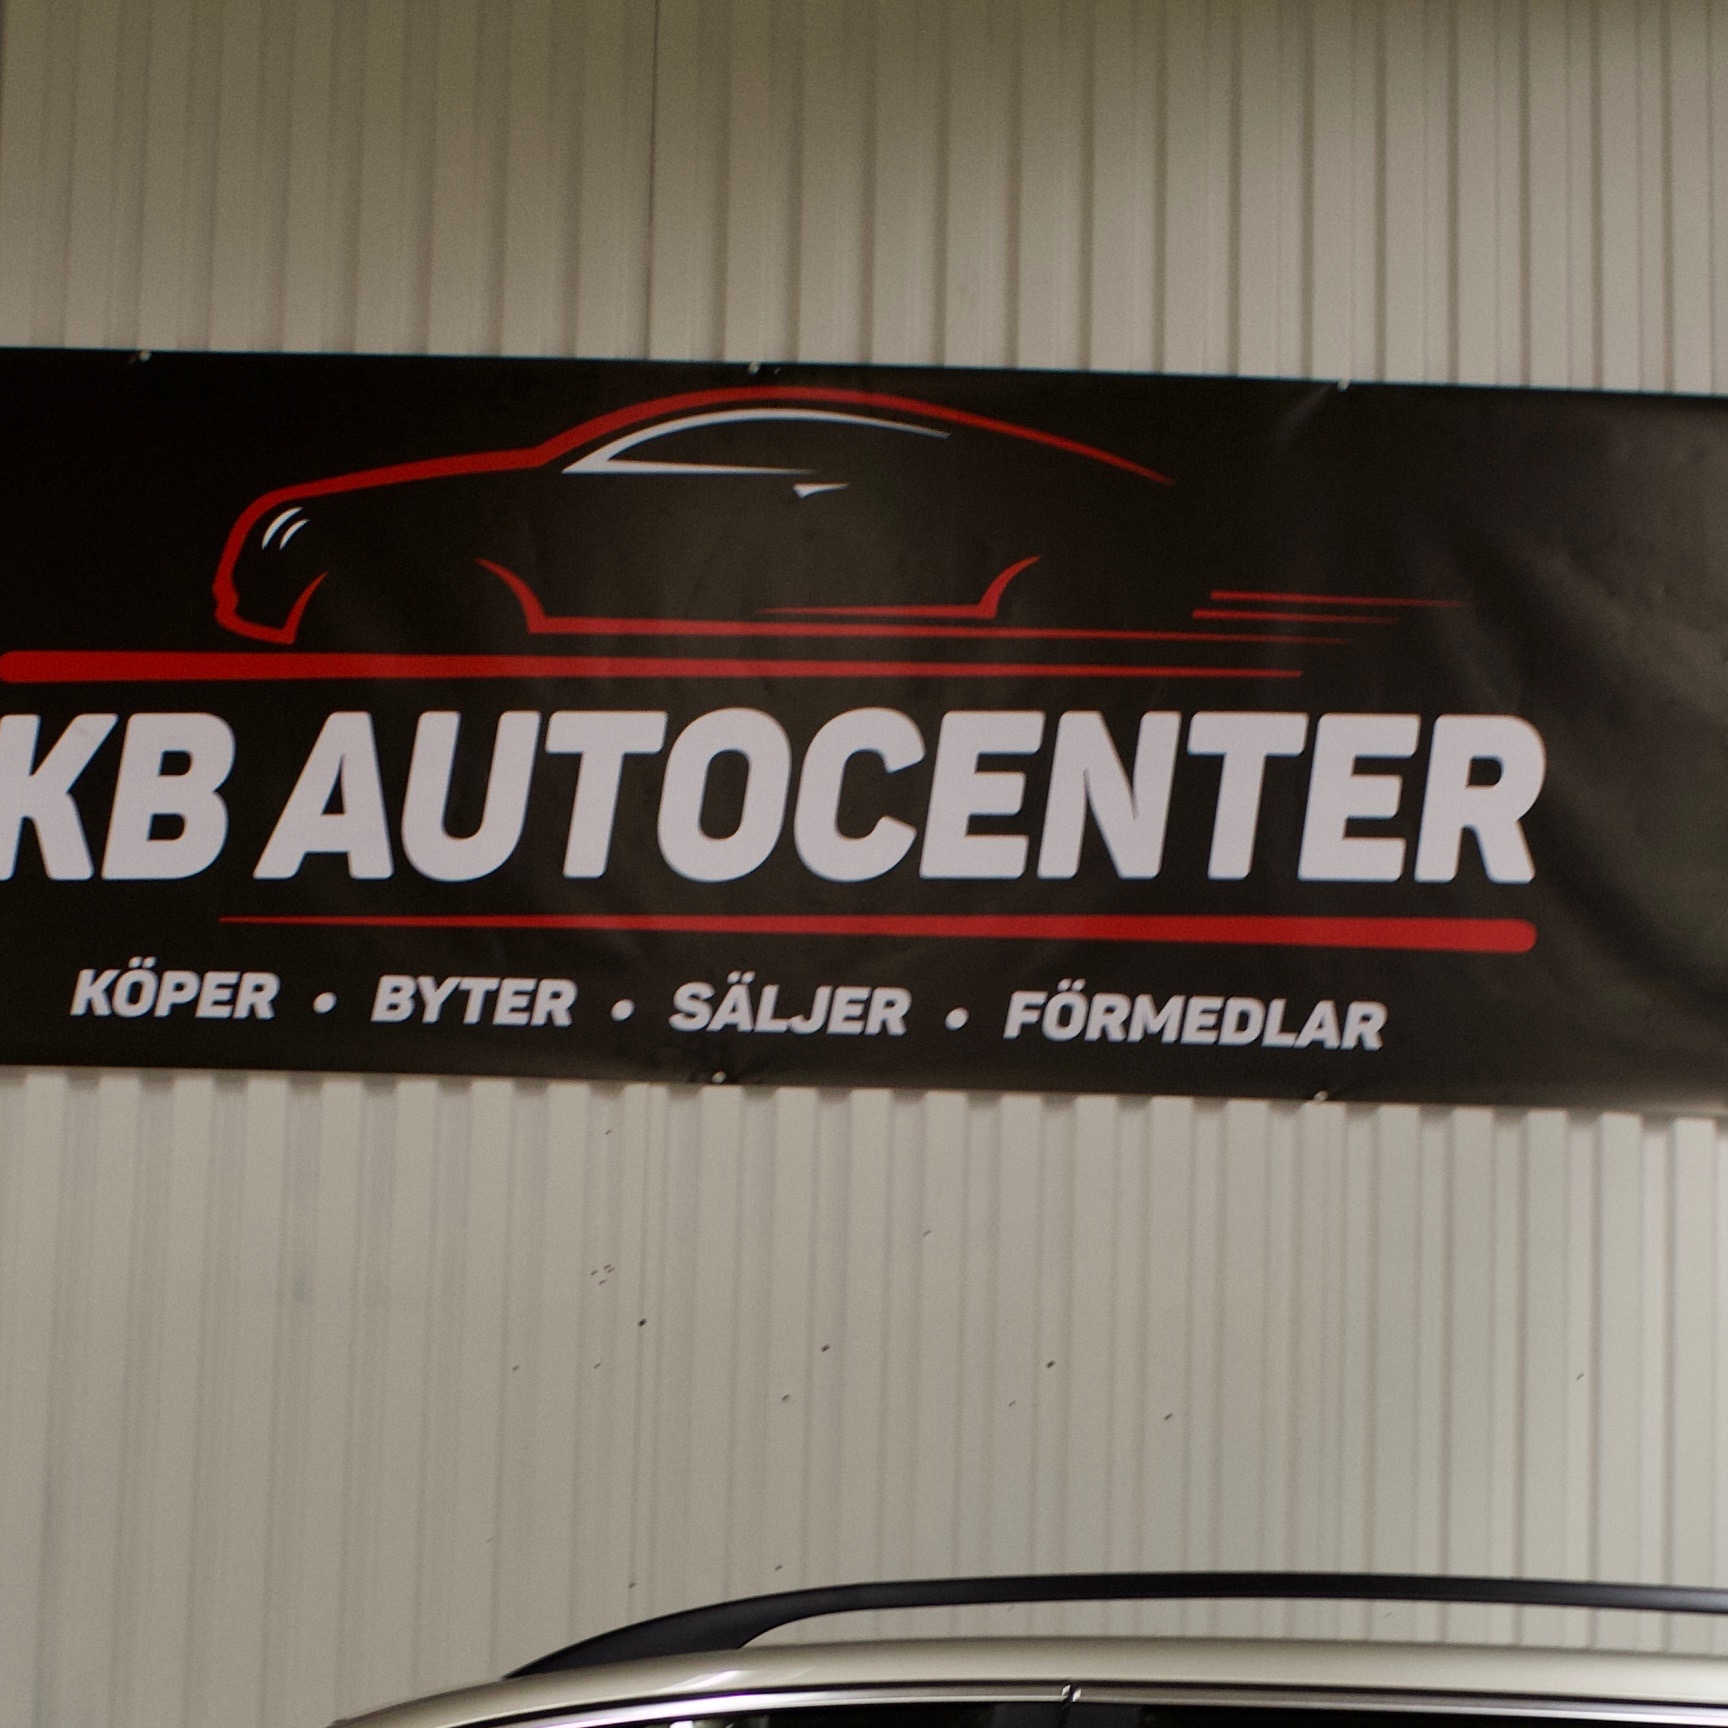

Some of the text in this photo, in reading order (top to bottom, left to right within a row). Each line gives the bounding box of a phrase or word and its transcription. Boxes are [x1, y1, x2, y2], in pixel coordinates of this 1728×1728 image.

[254, 708, 1545, 883] AUTOCENTER
[71, 957, 1386, 1050] KÖPER BYTER SÄLJER FÖRMEDLAR
